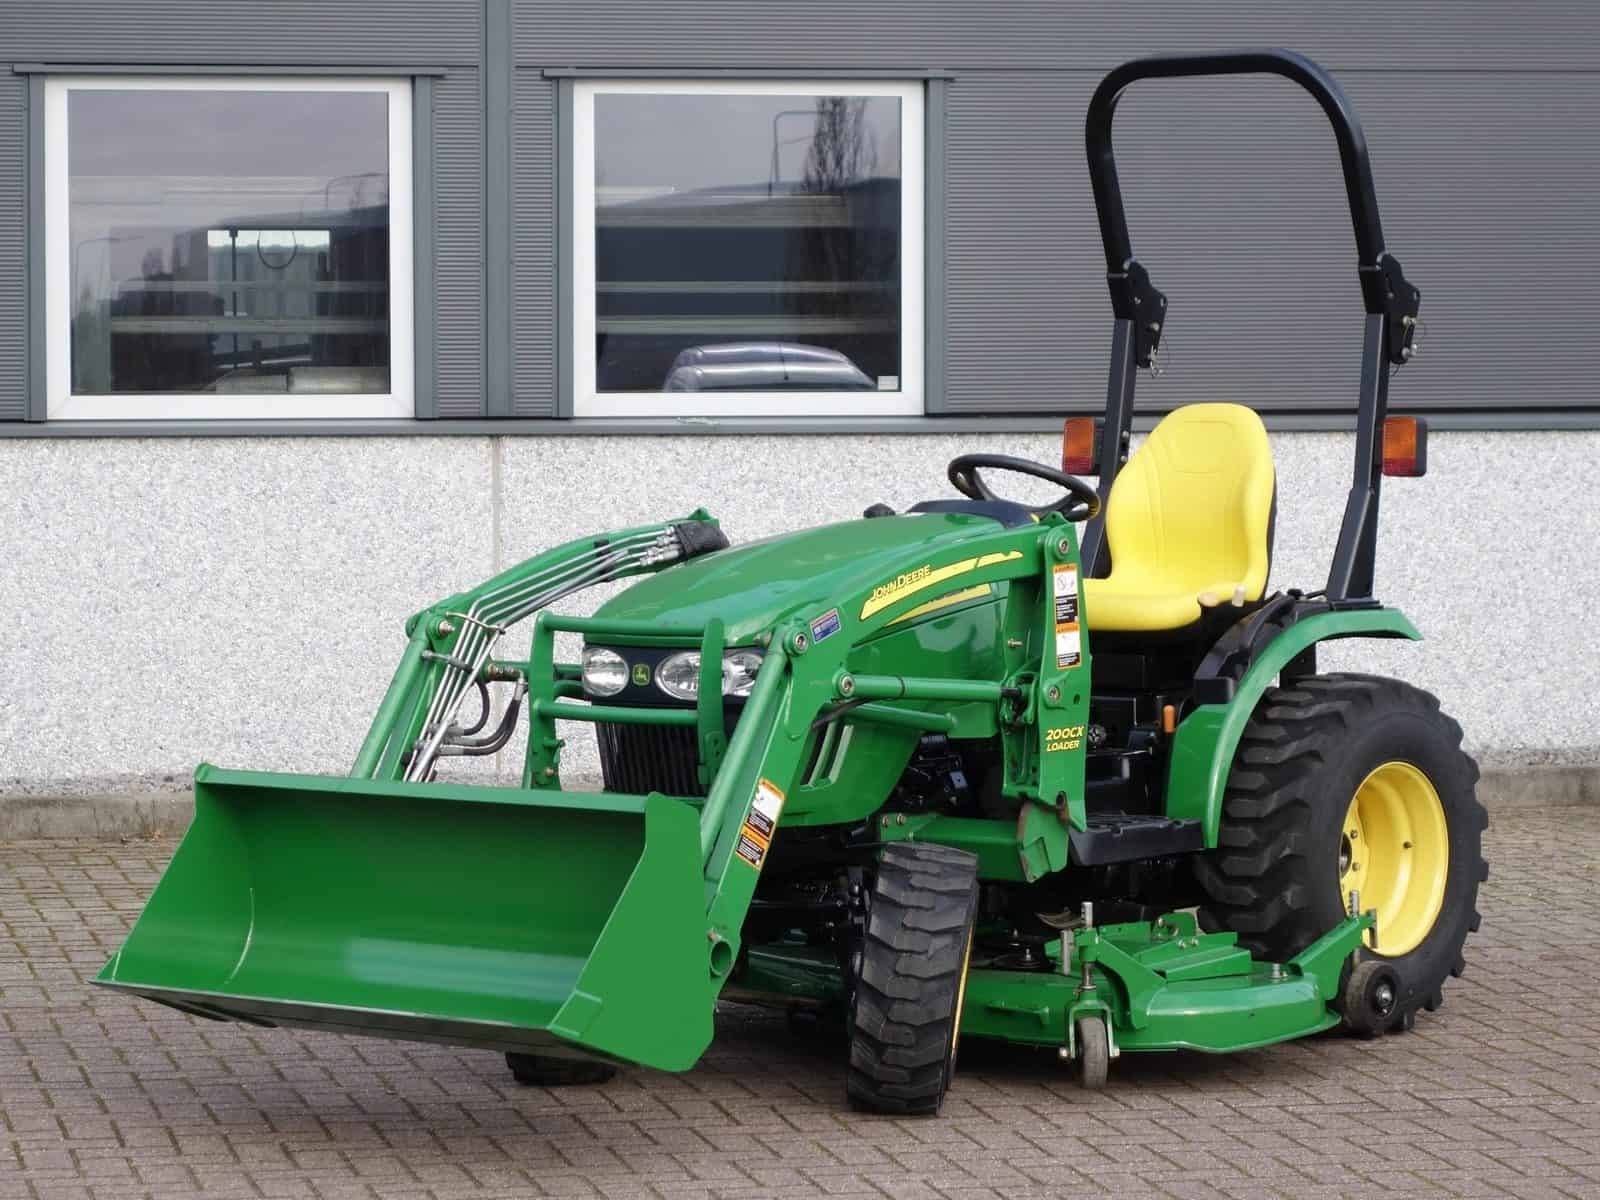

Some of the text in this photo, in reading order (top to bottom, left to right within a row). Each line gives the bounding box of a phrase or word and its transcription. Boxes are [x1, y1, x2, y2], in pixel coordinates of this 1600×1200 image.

[869, 564, 931, 600] JOHN DEERE
[1045, 725, 1085, 741] 200CX
[1046, 740, 1080, 752] LOADER
